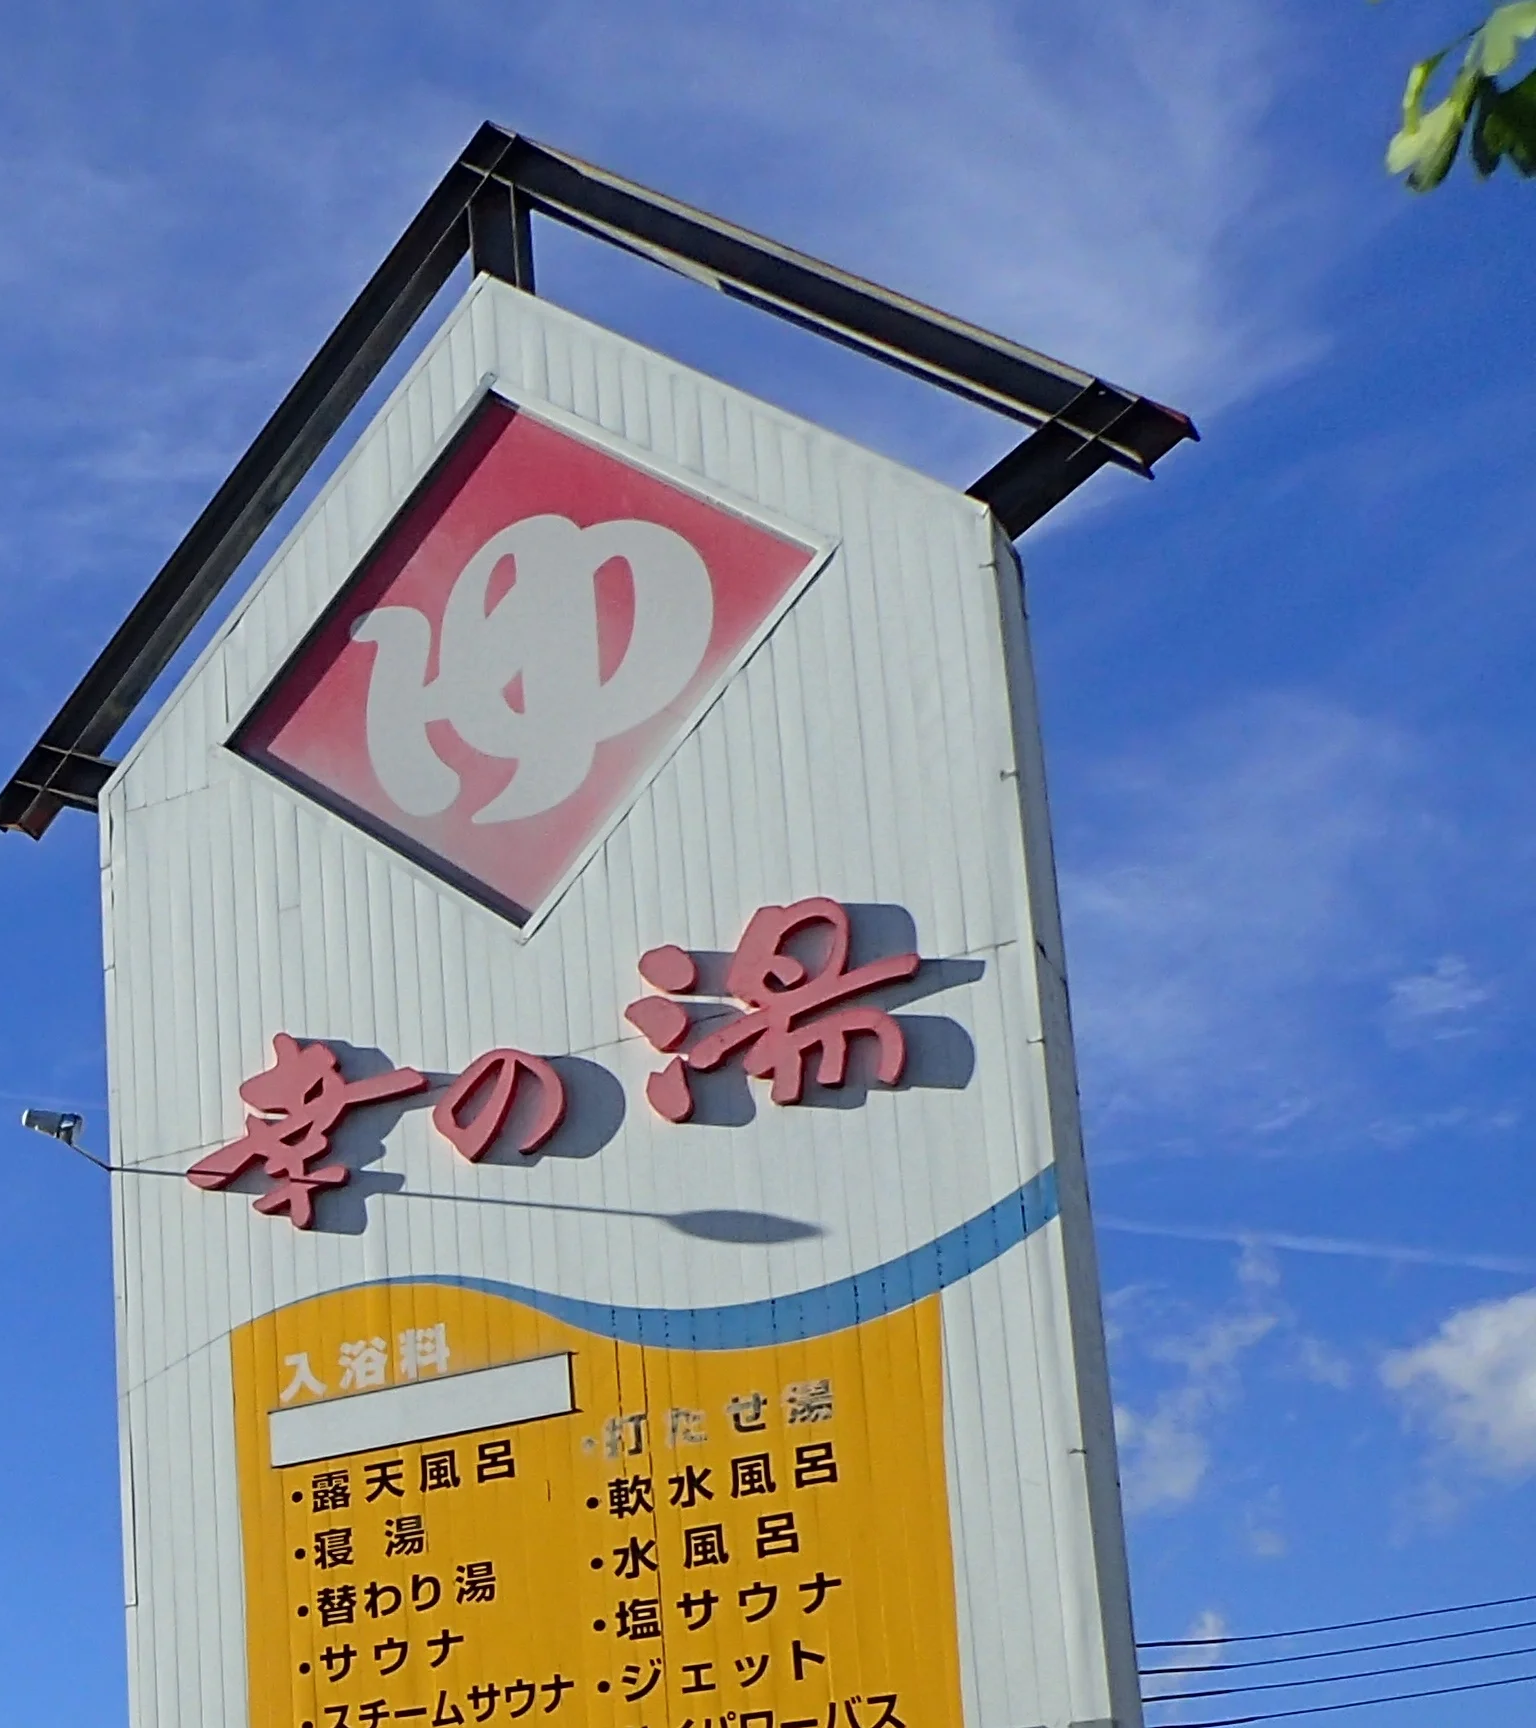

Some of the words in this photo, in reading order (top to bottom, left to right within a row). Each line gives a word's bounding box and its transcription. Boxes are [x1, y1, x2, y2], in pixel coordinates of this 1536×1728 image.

[351, 514, 713, 824] ゆ
[187, 897, 921, 1230] 幸の湯
[280, 1323, 450, 1402] 入浴料
